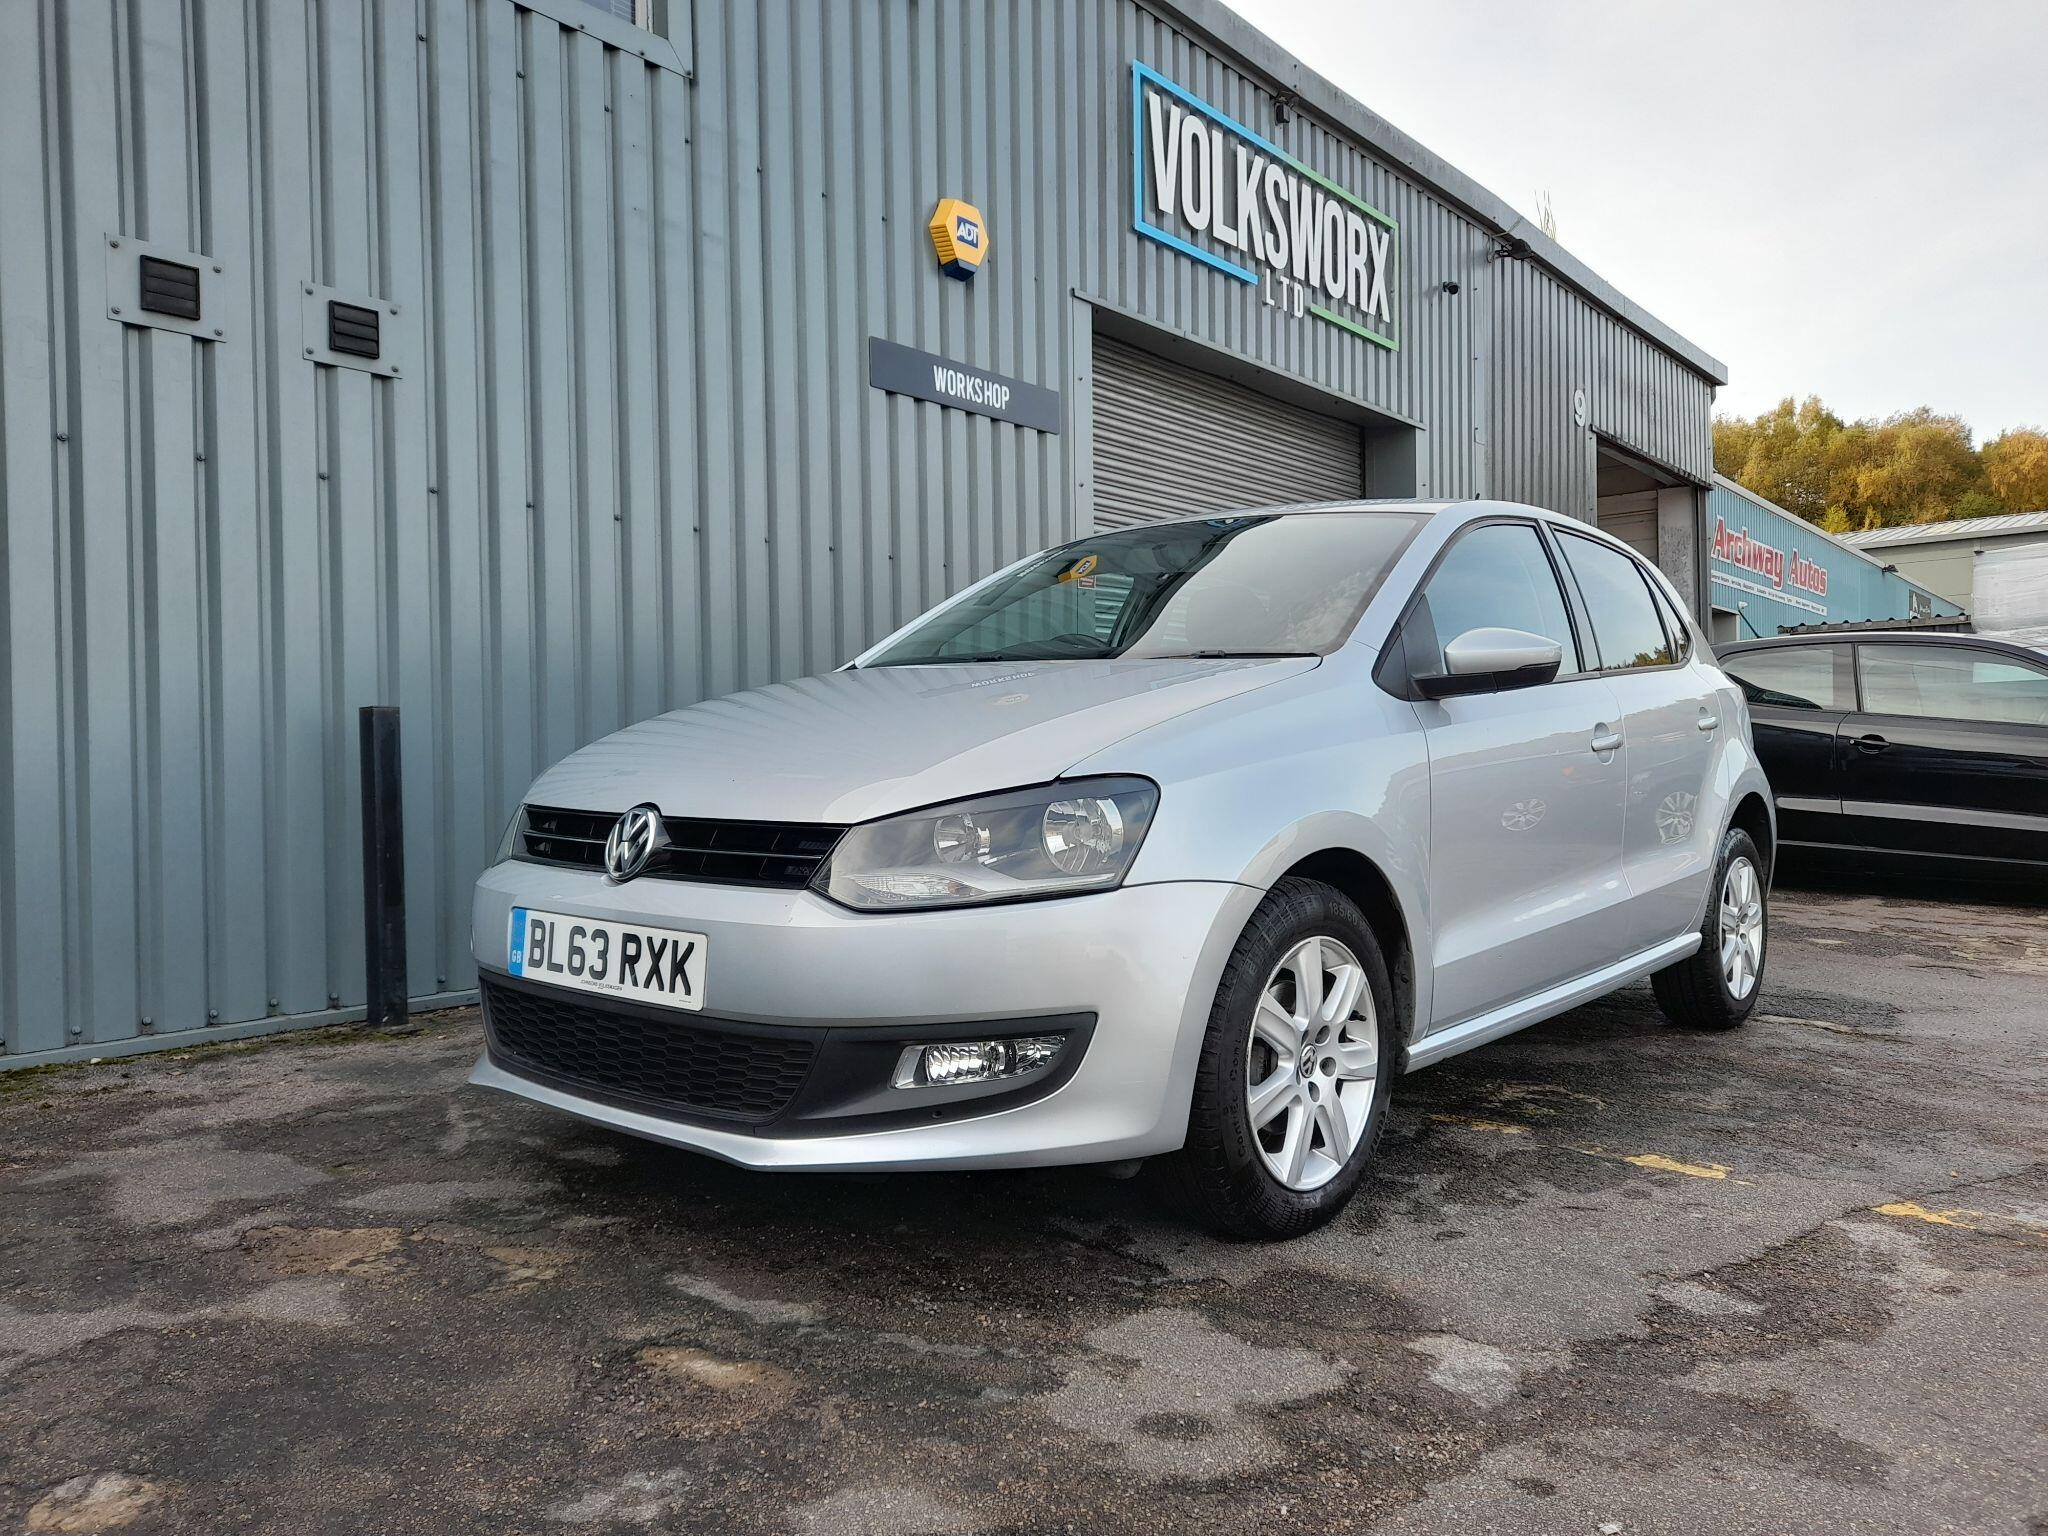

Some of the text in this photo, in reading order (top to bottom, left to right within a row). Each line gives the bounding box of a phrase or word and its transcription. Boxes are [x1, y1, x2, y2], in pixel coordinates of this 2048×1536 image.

[1149, 91, 1390, 323] VOLKSWORX
[956, 221, 979, 244] ADT
[1266, 269, 1304, 318] LTD
[933, 365, 1010, 410] WORKSHOP
[1574, 389, 1586, 427] 9
[1711, 515, 1784, 590] Archway
[1788, 548, 1827, 596] Autos
[511, 949, 522, 964] GB
[528, 919, 695, 996] BL63 RXK
